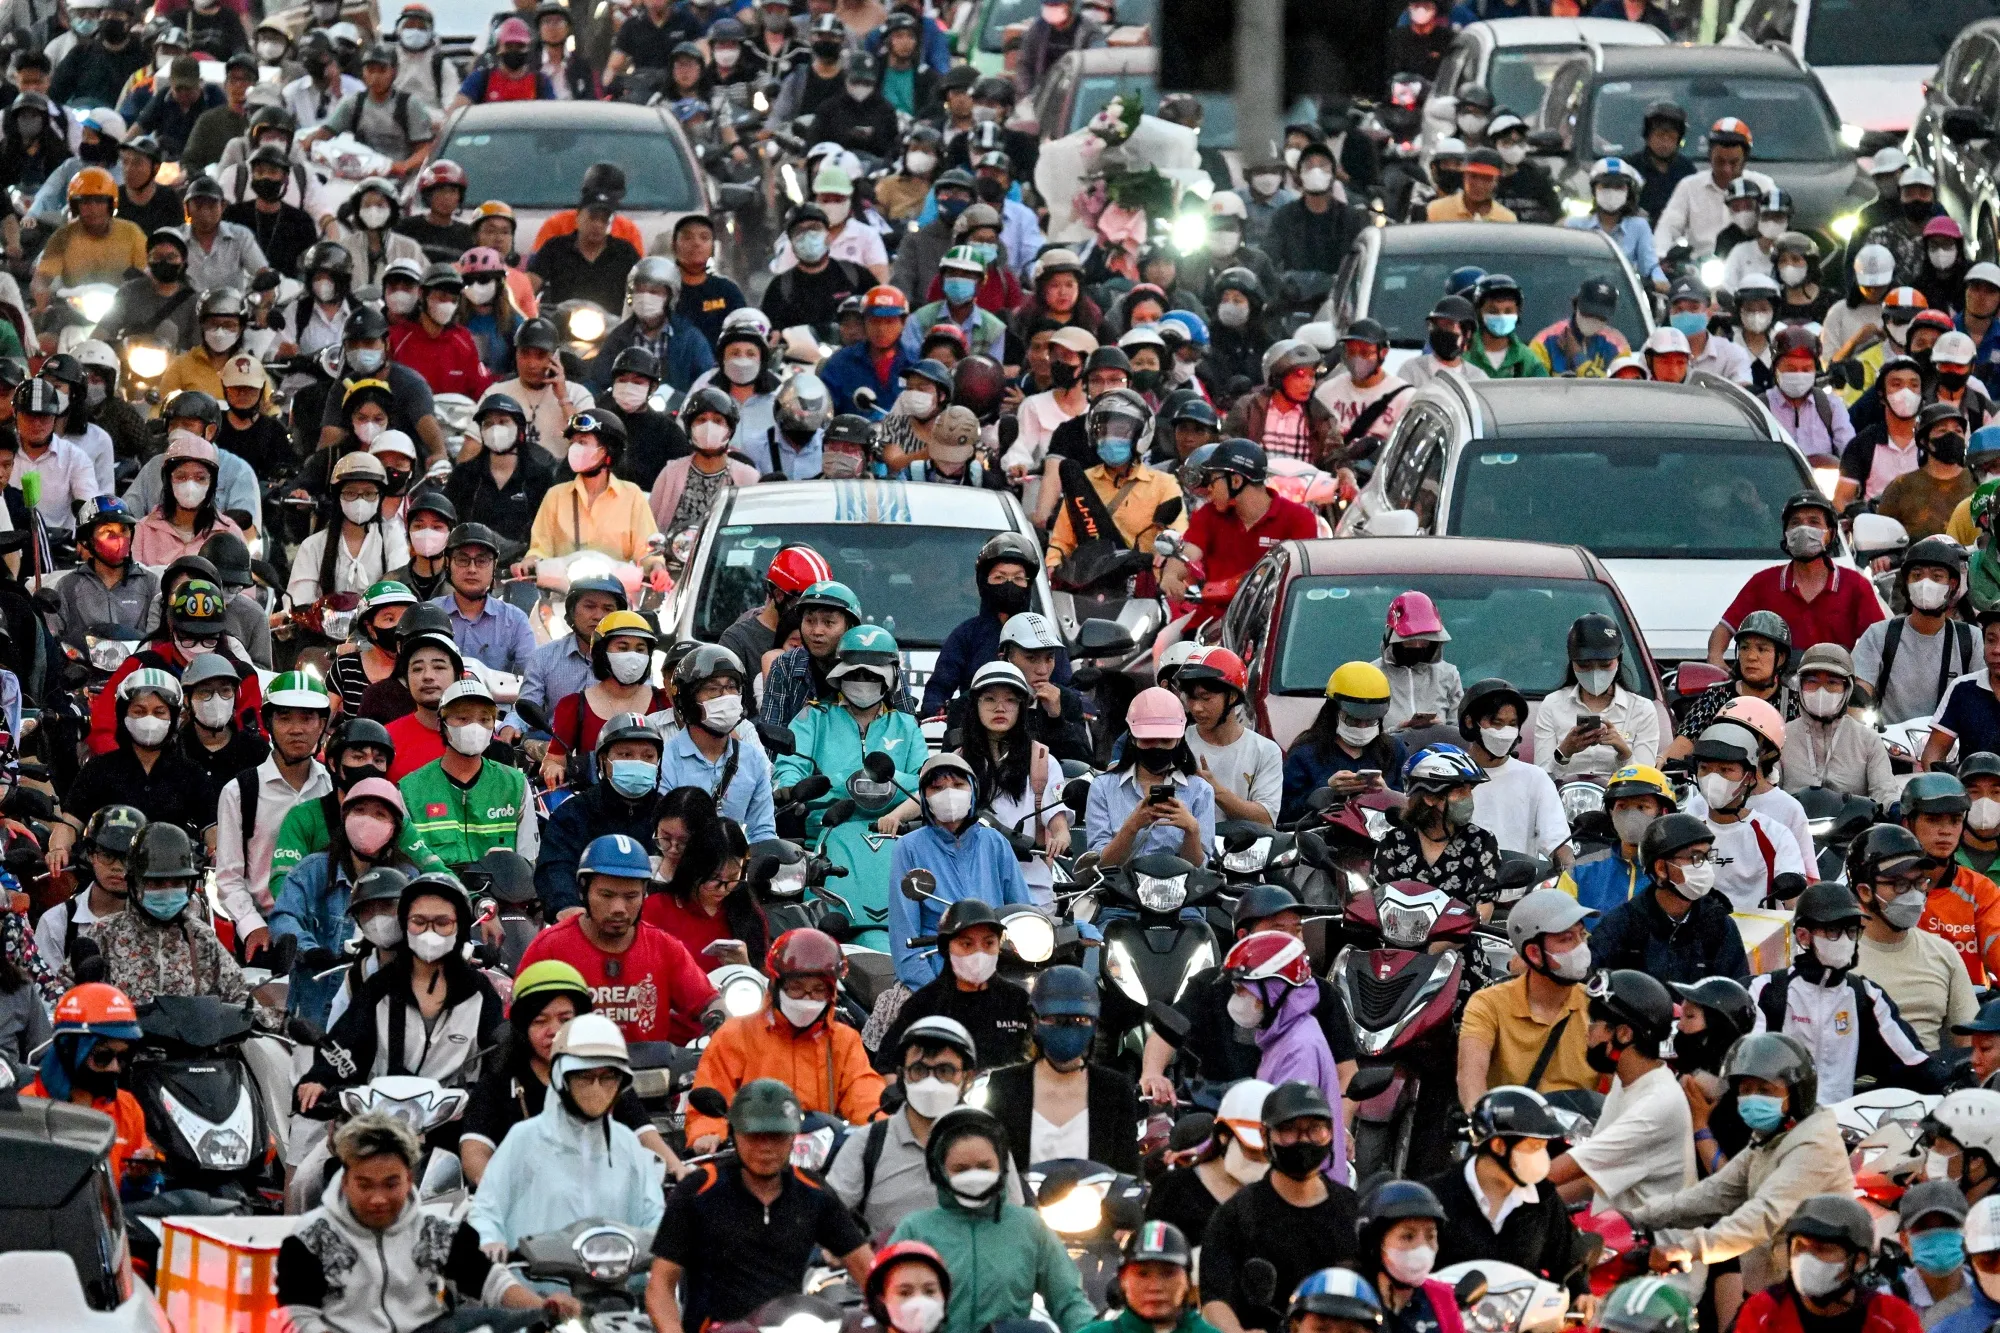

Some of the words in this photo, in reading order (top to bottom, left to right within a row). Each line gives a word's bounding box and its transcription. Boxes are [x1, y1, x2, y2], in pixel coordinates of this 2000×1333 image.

[487, 803, 515, 819] Grab
[274, 848, 302, 861] Grab
[587, 986, 639, 1004] OREA
